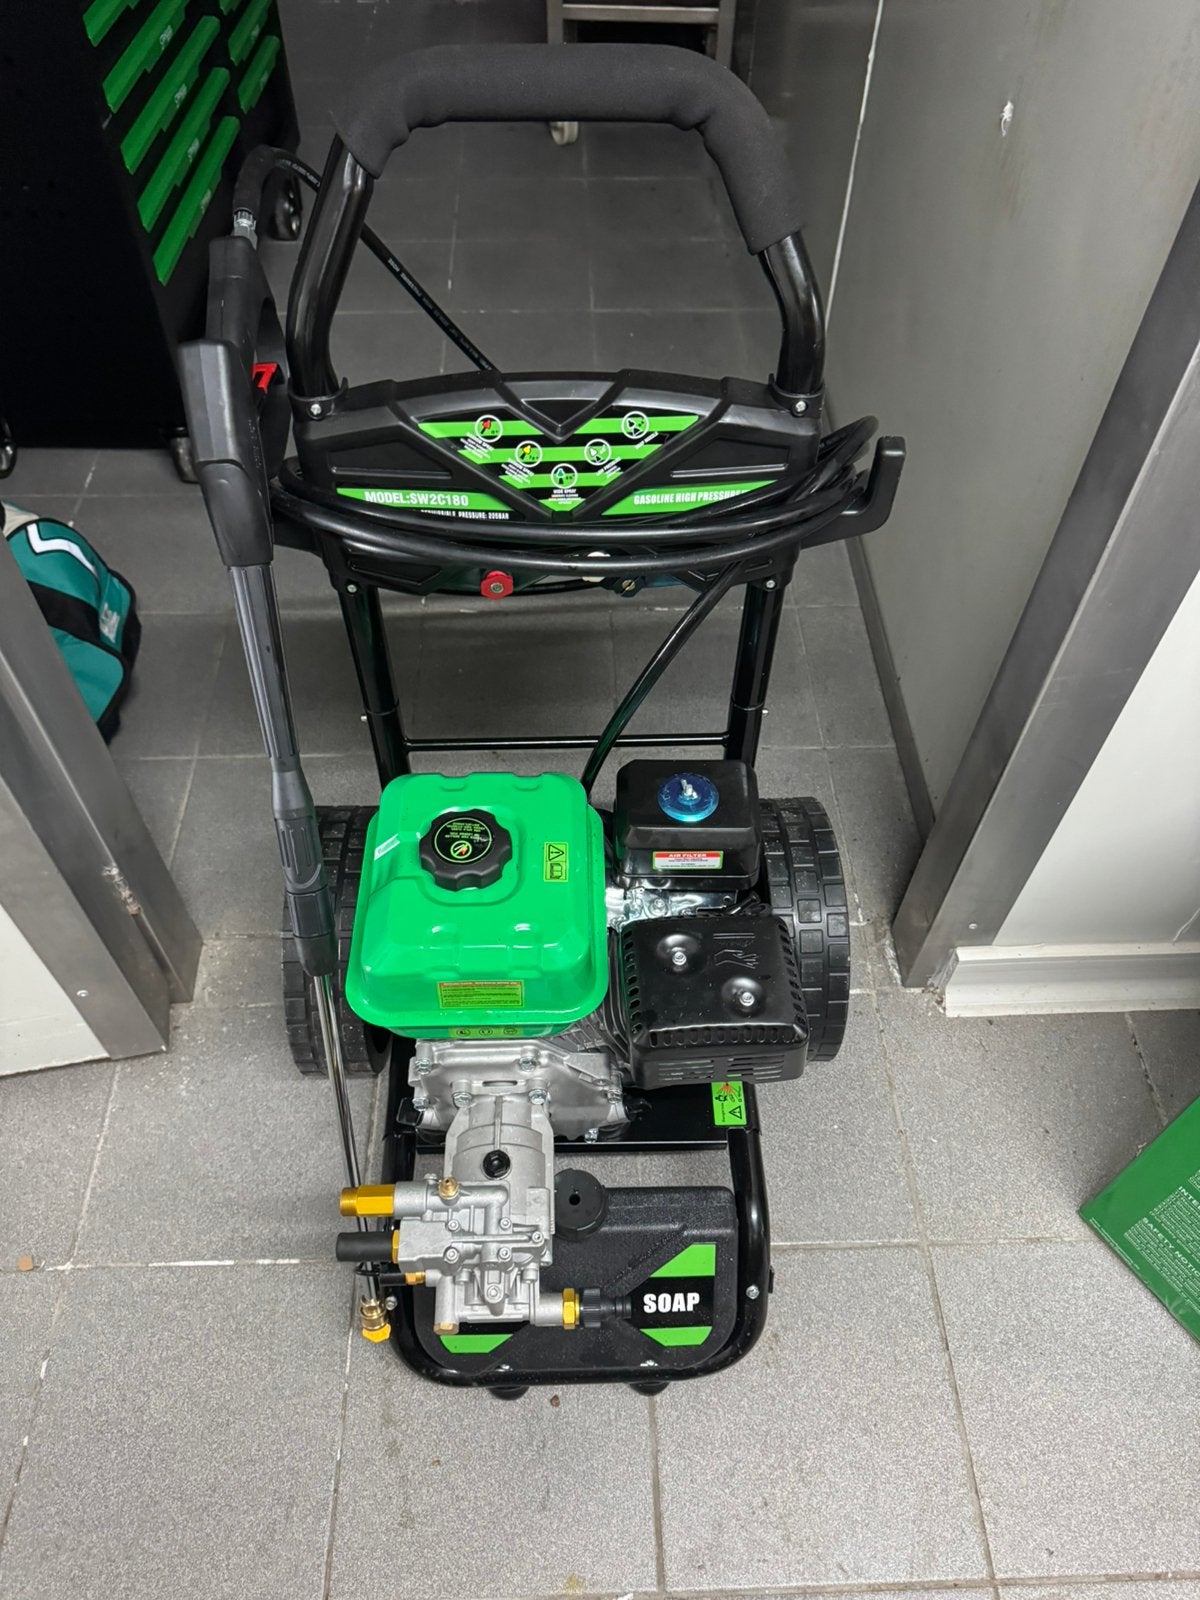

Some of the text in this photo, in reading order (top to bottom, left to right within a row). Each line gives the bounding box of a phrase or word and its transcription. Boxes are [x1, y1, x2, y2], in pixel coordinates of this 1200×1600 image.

[364, 491, 469, 506] MODEL:SW2C180
[633, 493, 674, 505] GASOLINE
[675, 491, 697, 503] HIGH
[1141, 1216, 1175, 1250] SAFETY
[643, 1291, 700, 1314] SOAP
